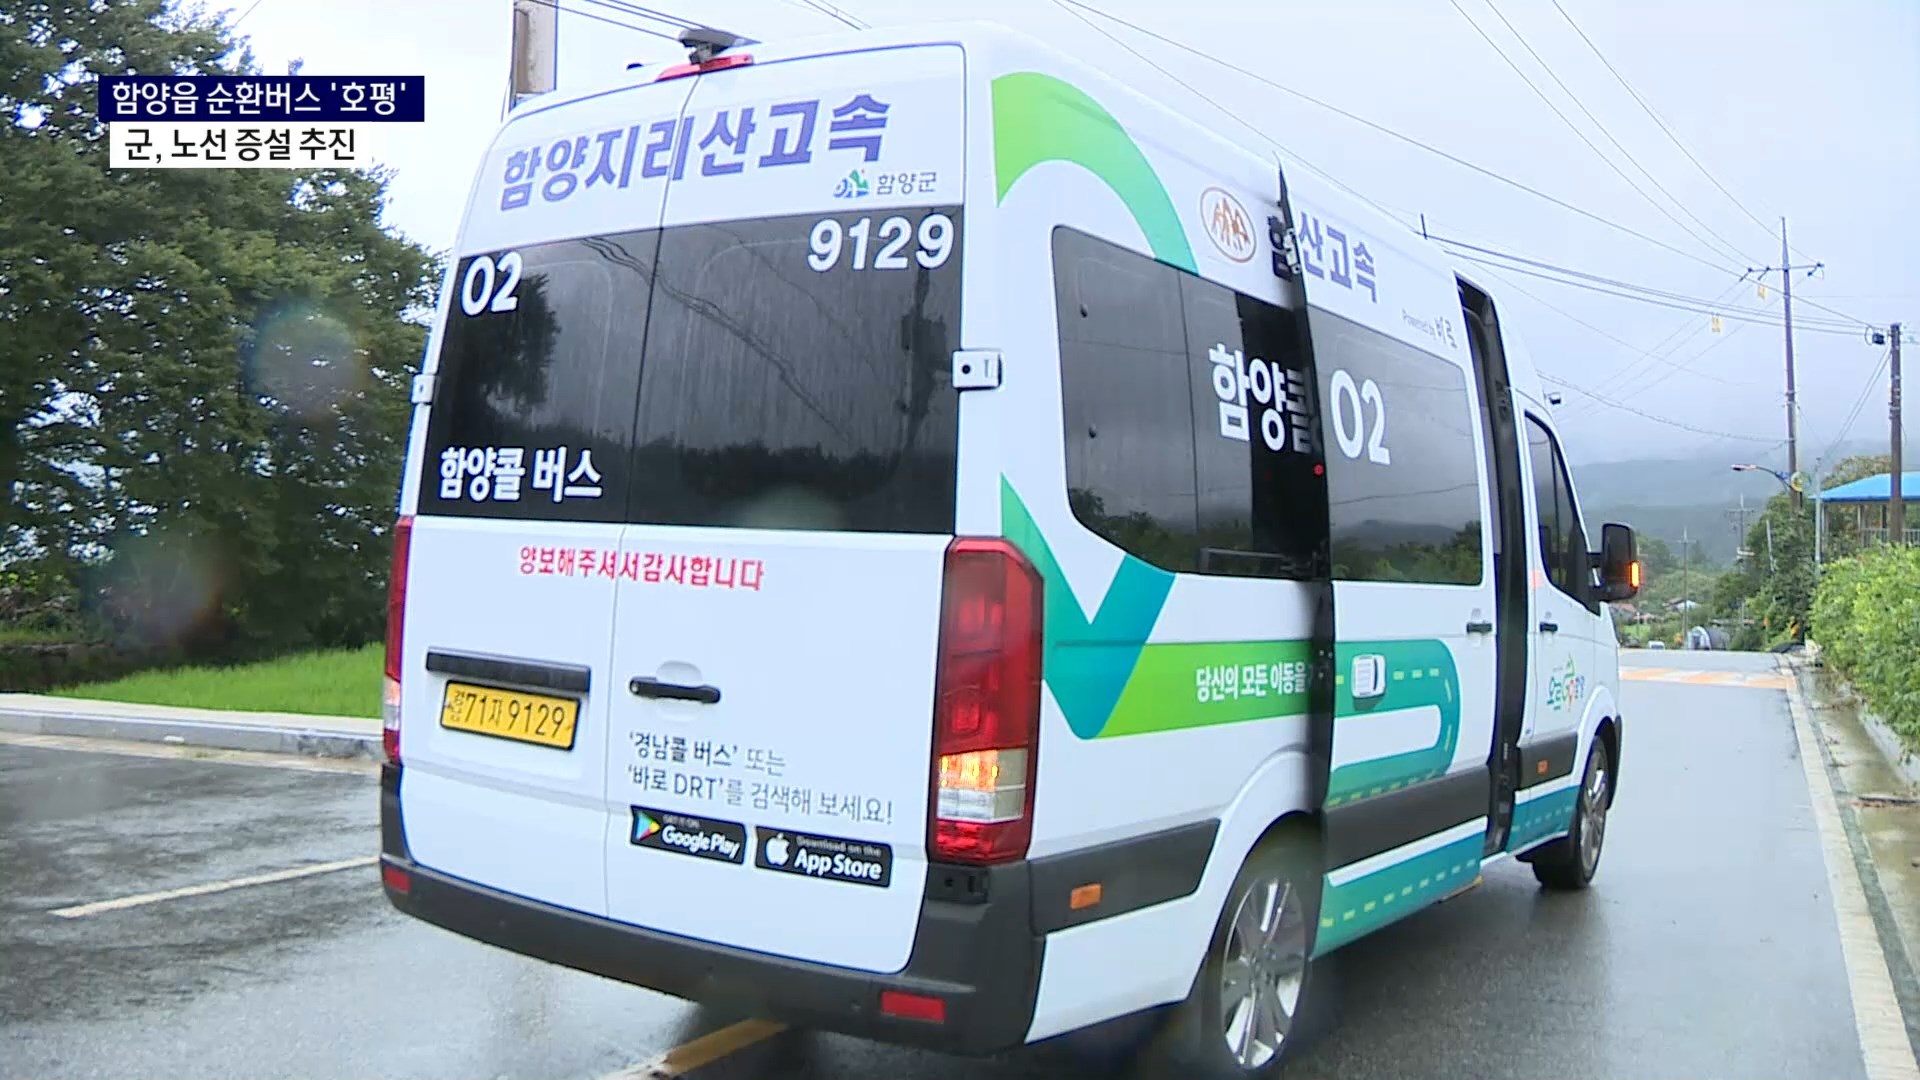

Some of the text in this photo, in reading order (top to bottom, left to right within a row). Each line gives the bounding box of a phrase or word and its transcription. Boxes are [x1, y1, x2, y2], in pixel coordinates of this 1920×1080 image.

[500, 94, 890, 211] 함양지리산고속
[877, 172, 937, 195] 함양군
[807, 213, 955, 272] 9129
[461, 251, 522, 316] 02
[1330, 369, 1390, 465] 02
[440, 446, 604, 502] 함양콜 버스
[1196, 663, 1239, 703] 당신의
[1241, 664, 1268, 697] 모든
[1270, 661, 1306, 695] 이동을
[745, 748, 786, 777] 또는
[751, 782, 811, 815] 검색해
[817, 791, 893, 824] 보세요!
[662, 824, 740, 859] Google Play
[794, 847, 882, 881] App Store
